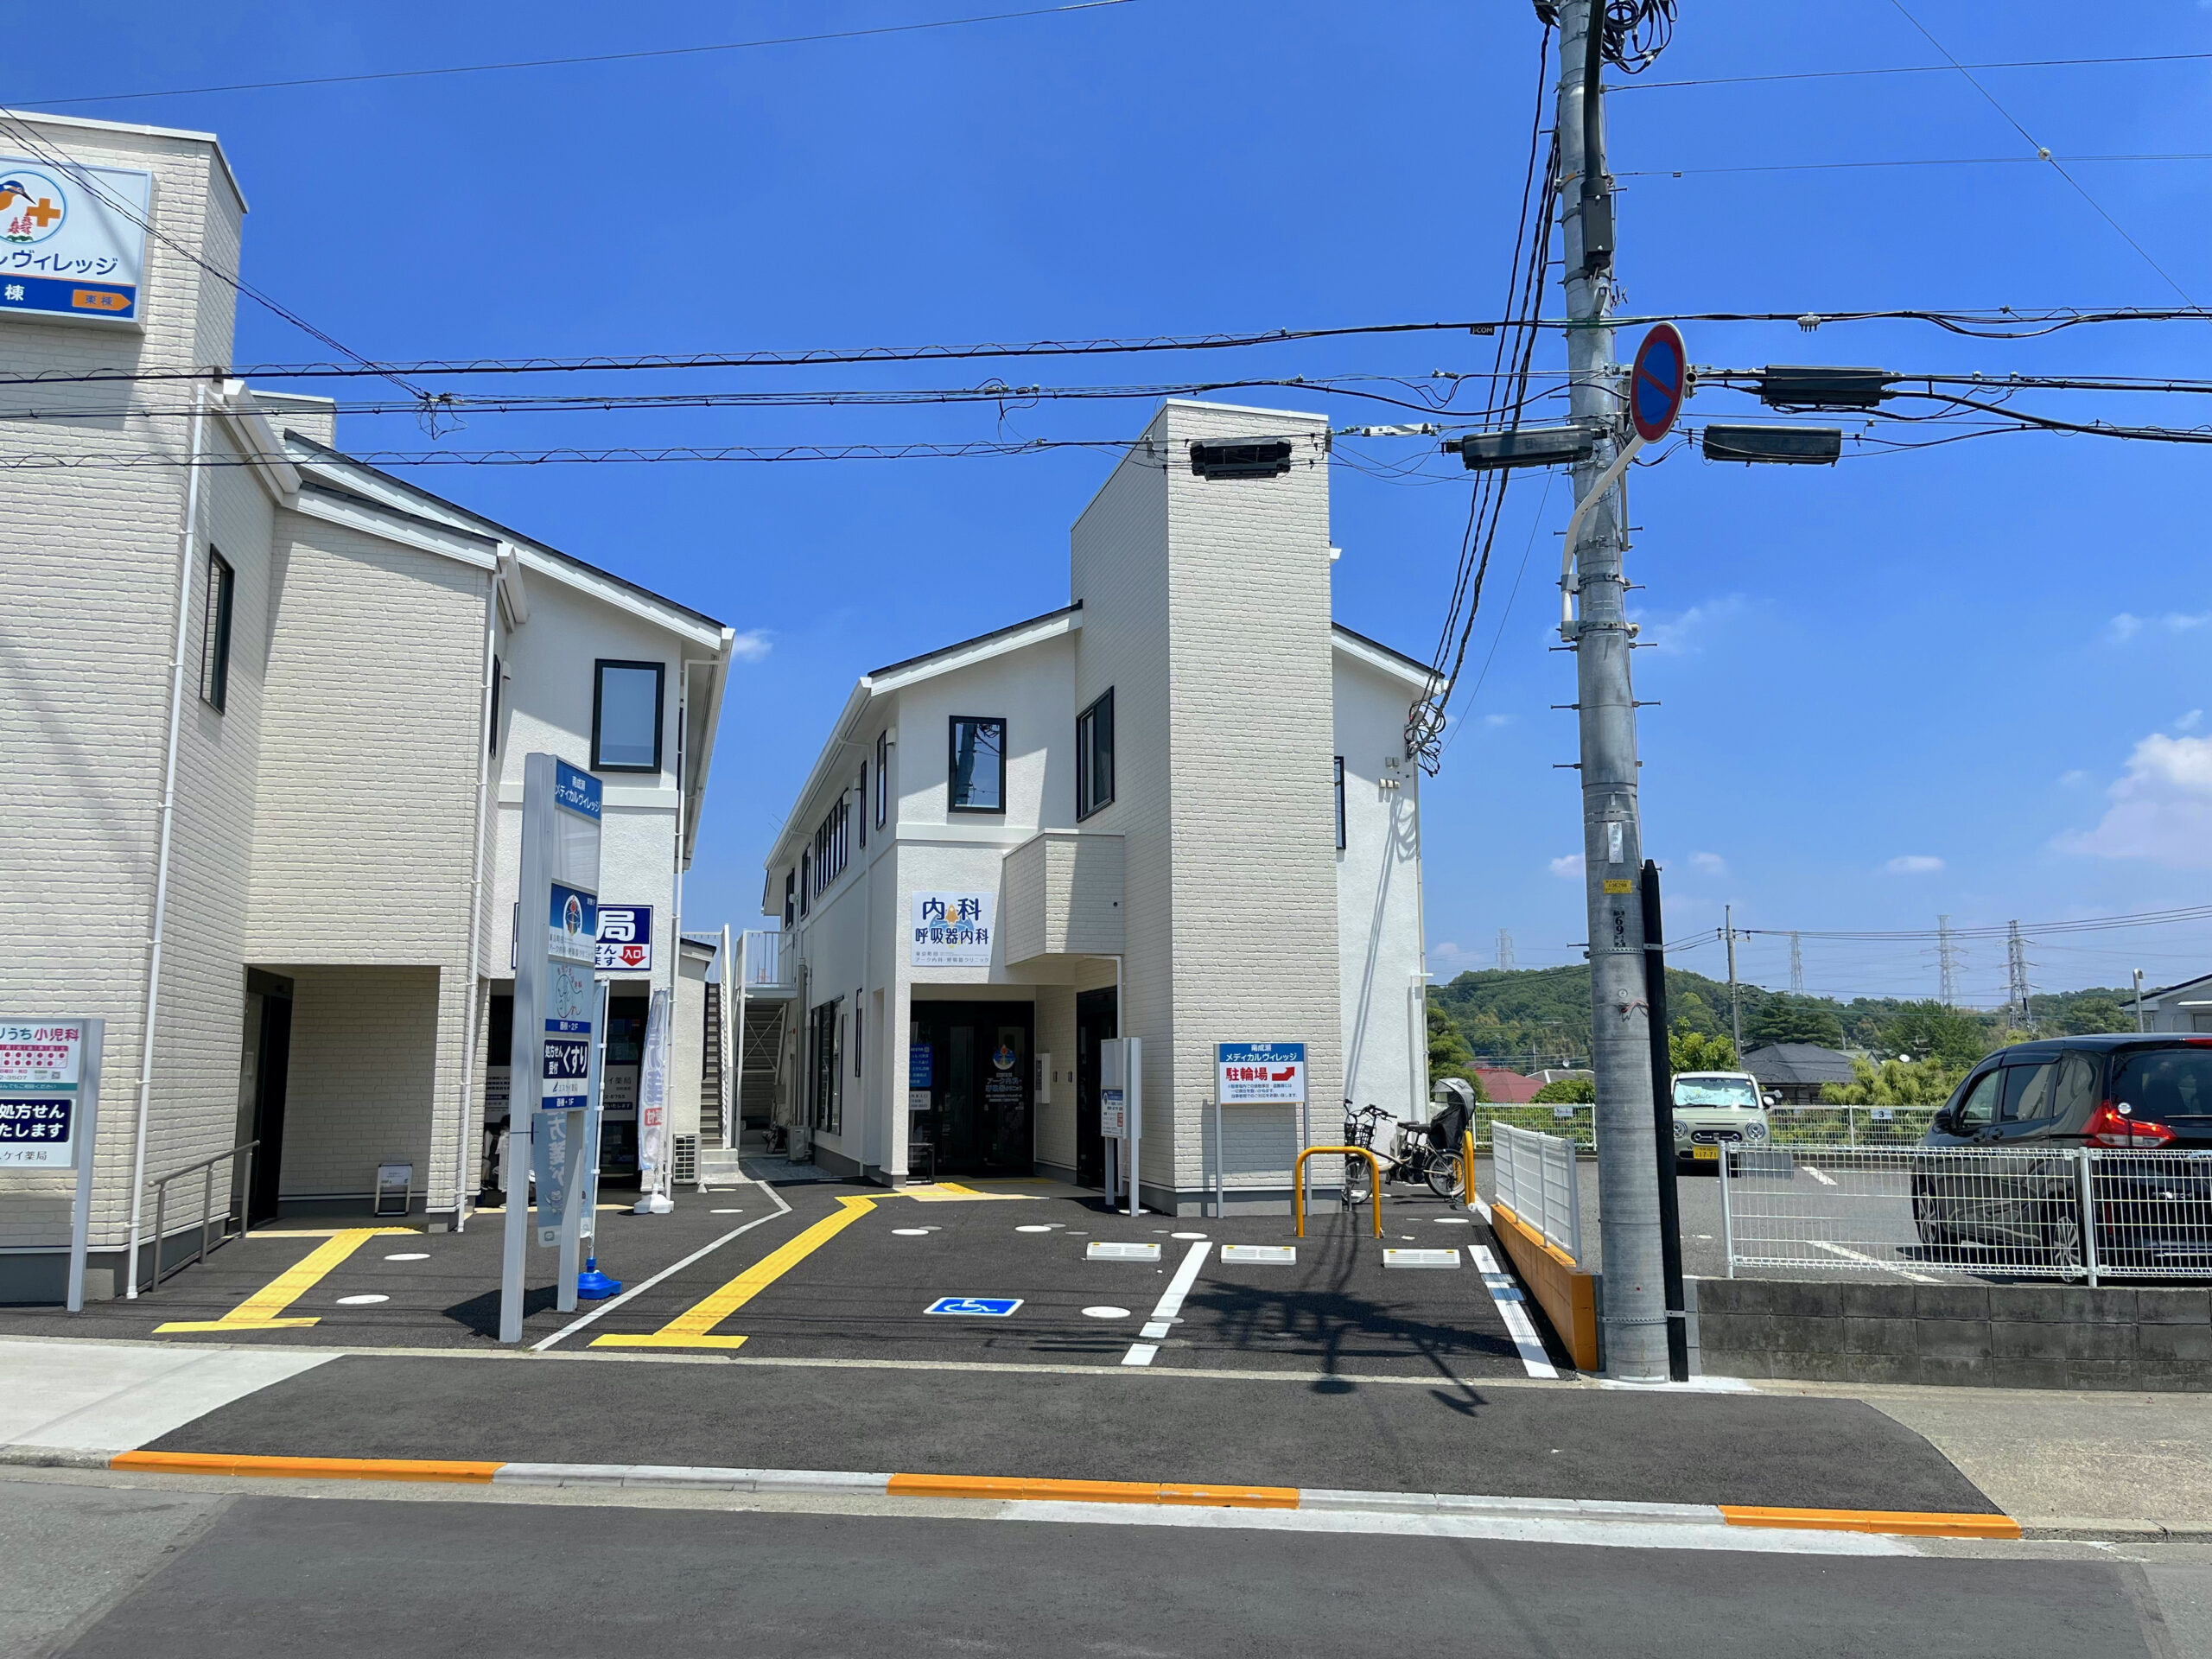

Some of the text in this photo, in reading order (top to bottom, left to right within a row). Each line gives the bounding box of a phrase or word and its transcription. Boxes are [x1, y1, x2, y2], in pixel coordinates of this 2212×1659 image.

[4, 283, 25, 302] 棟
[555, 784, 601, 813] メディカルヴィレッジ
[922, 897, 982, 921] 内科
[596, 910, 636, 942] 局
[915, 927, 989, 944] 呼吸器内科
[624, 949, 641, 959] 入口
[545, 1044, 563, 1058] 処方せん
[1225, 1052, 1297, 1062] メディカルヴィレッジ
[563, 1045, 588, 1074] くすり
[549, 1061, 559, 1075] 受付
[1225, 1066, 1268, 1081] 駐輪場
[0, 1104, 66, 1120] 処方せん
[0, 1151, 48, 1161] ケイ薬局
